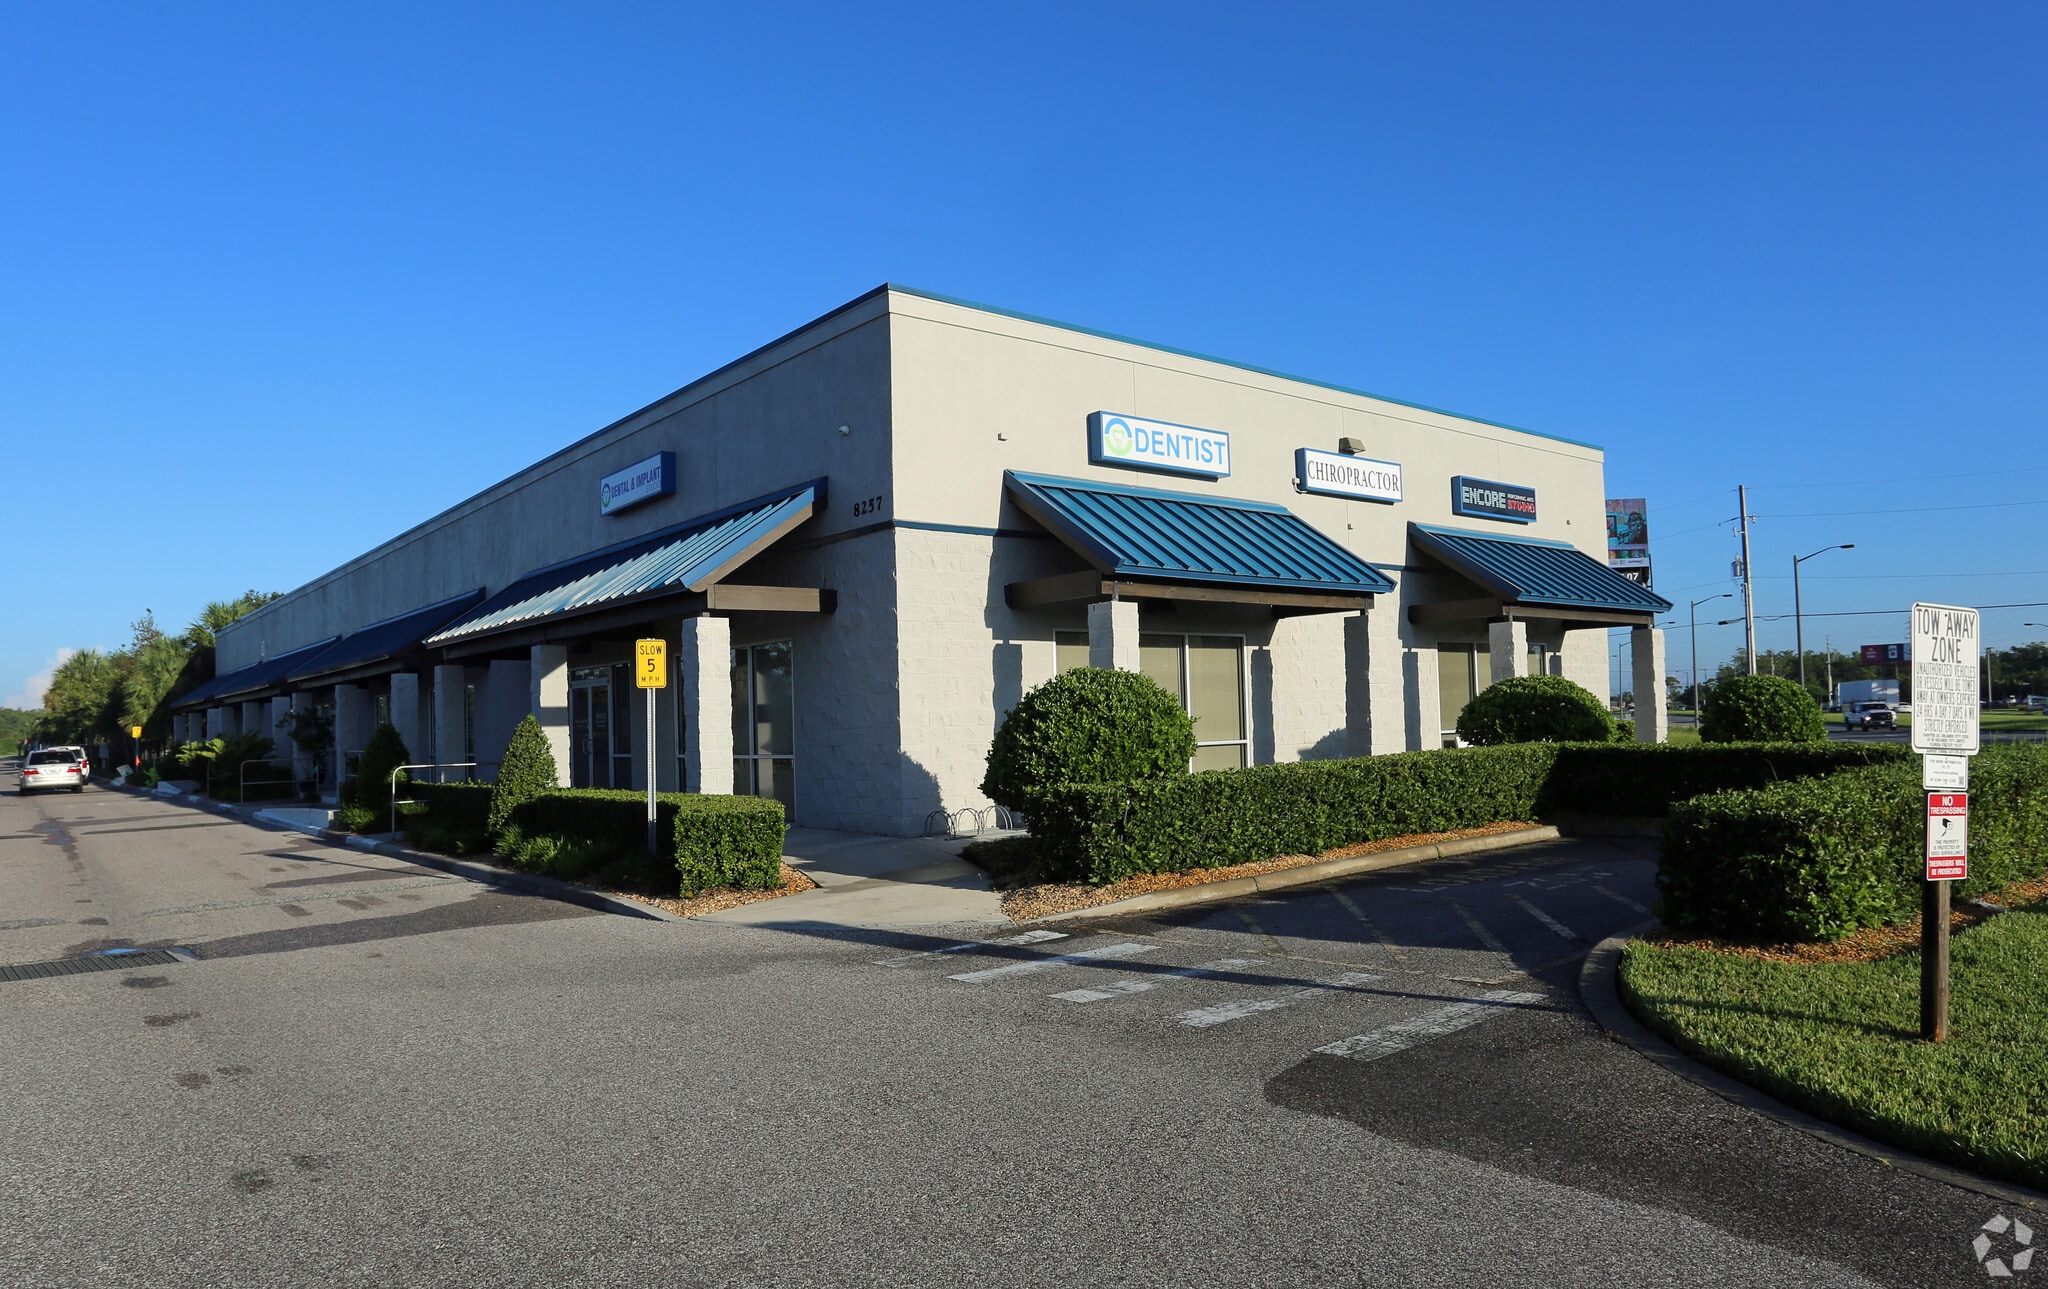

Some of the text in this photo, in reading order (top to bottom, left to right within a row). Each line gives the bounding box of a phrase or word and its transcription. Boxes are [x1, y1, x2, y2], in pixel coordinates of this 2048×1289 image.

[1135, 427, 1226, 465] DENTIST
[611, 467, 660, 499] DENTAL & IMPLANT
[1307, 460, 1400, 492] CHIROPRACTOR
[853, 495, 882, 517] 8257
[1462, 486, 1506, 509] ENCORE
[1507, 499, 1536, 513] STUDIO
[1916, 608, 1975, 639] TOW AWAY
[640, 645, 663, 655] SLOW
[1931, 636, 1961, 664] ZONE
[647, 658, 655, 673] 5
[1916, 662, 1976, 679] UNAUTHORIZED VEHICLES
[1916, 675, 1976, 692] OR VESSELS WILL BE TOWED
[1916, 690, 1928, 703] AWAY
[1929, 690, 1935, 704] AT
[1956, 692, 1976, 706] EXPENSE
[1916, 703, 1923, 718] 24
[1923, 704, 1933, 718] HRS
[1934, 705, 1938, 718] A
[1939, 705, 1948, 719] DAY
[1948, 705, 1952, 719] 7
[1952, 706, 1963, 719] DAYS
[1964, 706, 1968, 720] A
[1924, 718, 1967, 733] STRICTLY ENFORCED
[1942, 796, 1953, 806] NO
[1930, 807, 1966, 815] TRESPASSING
